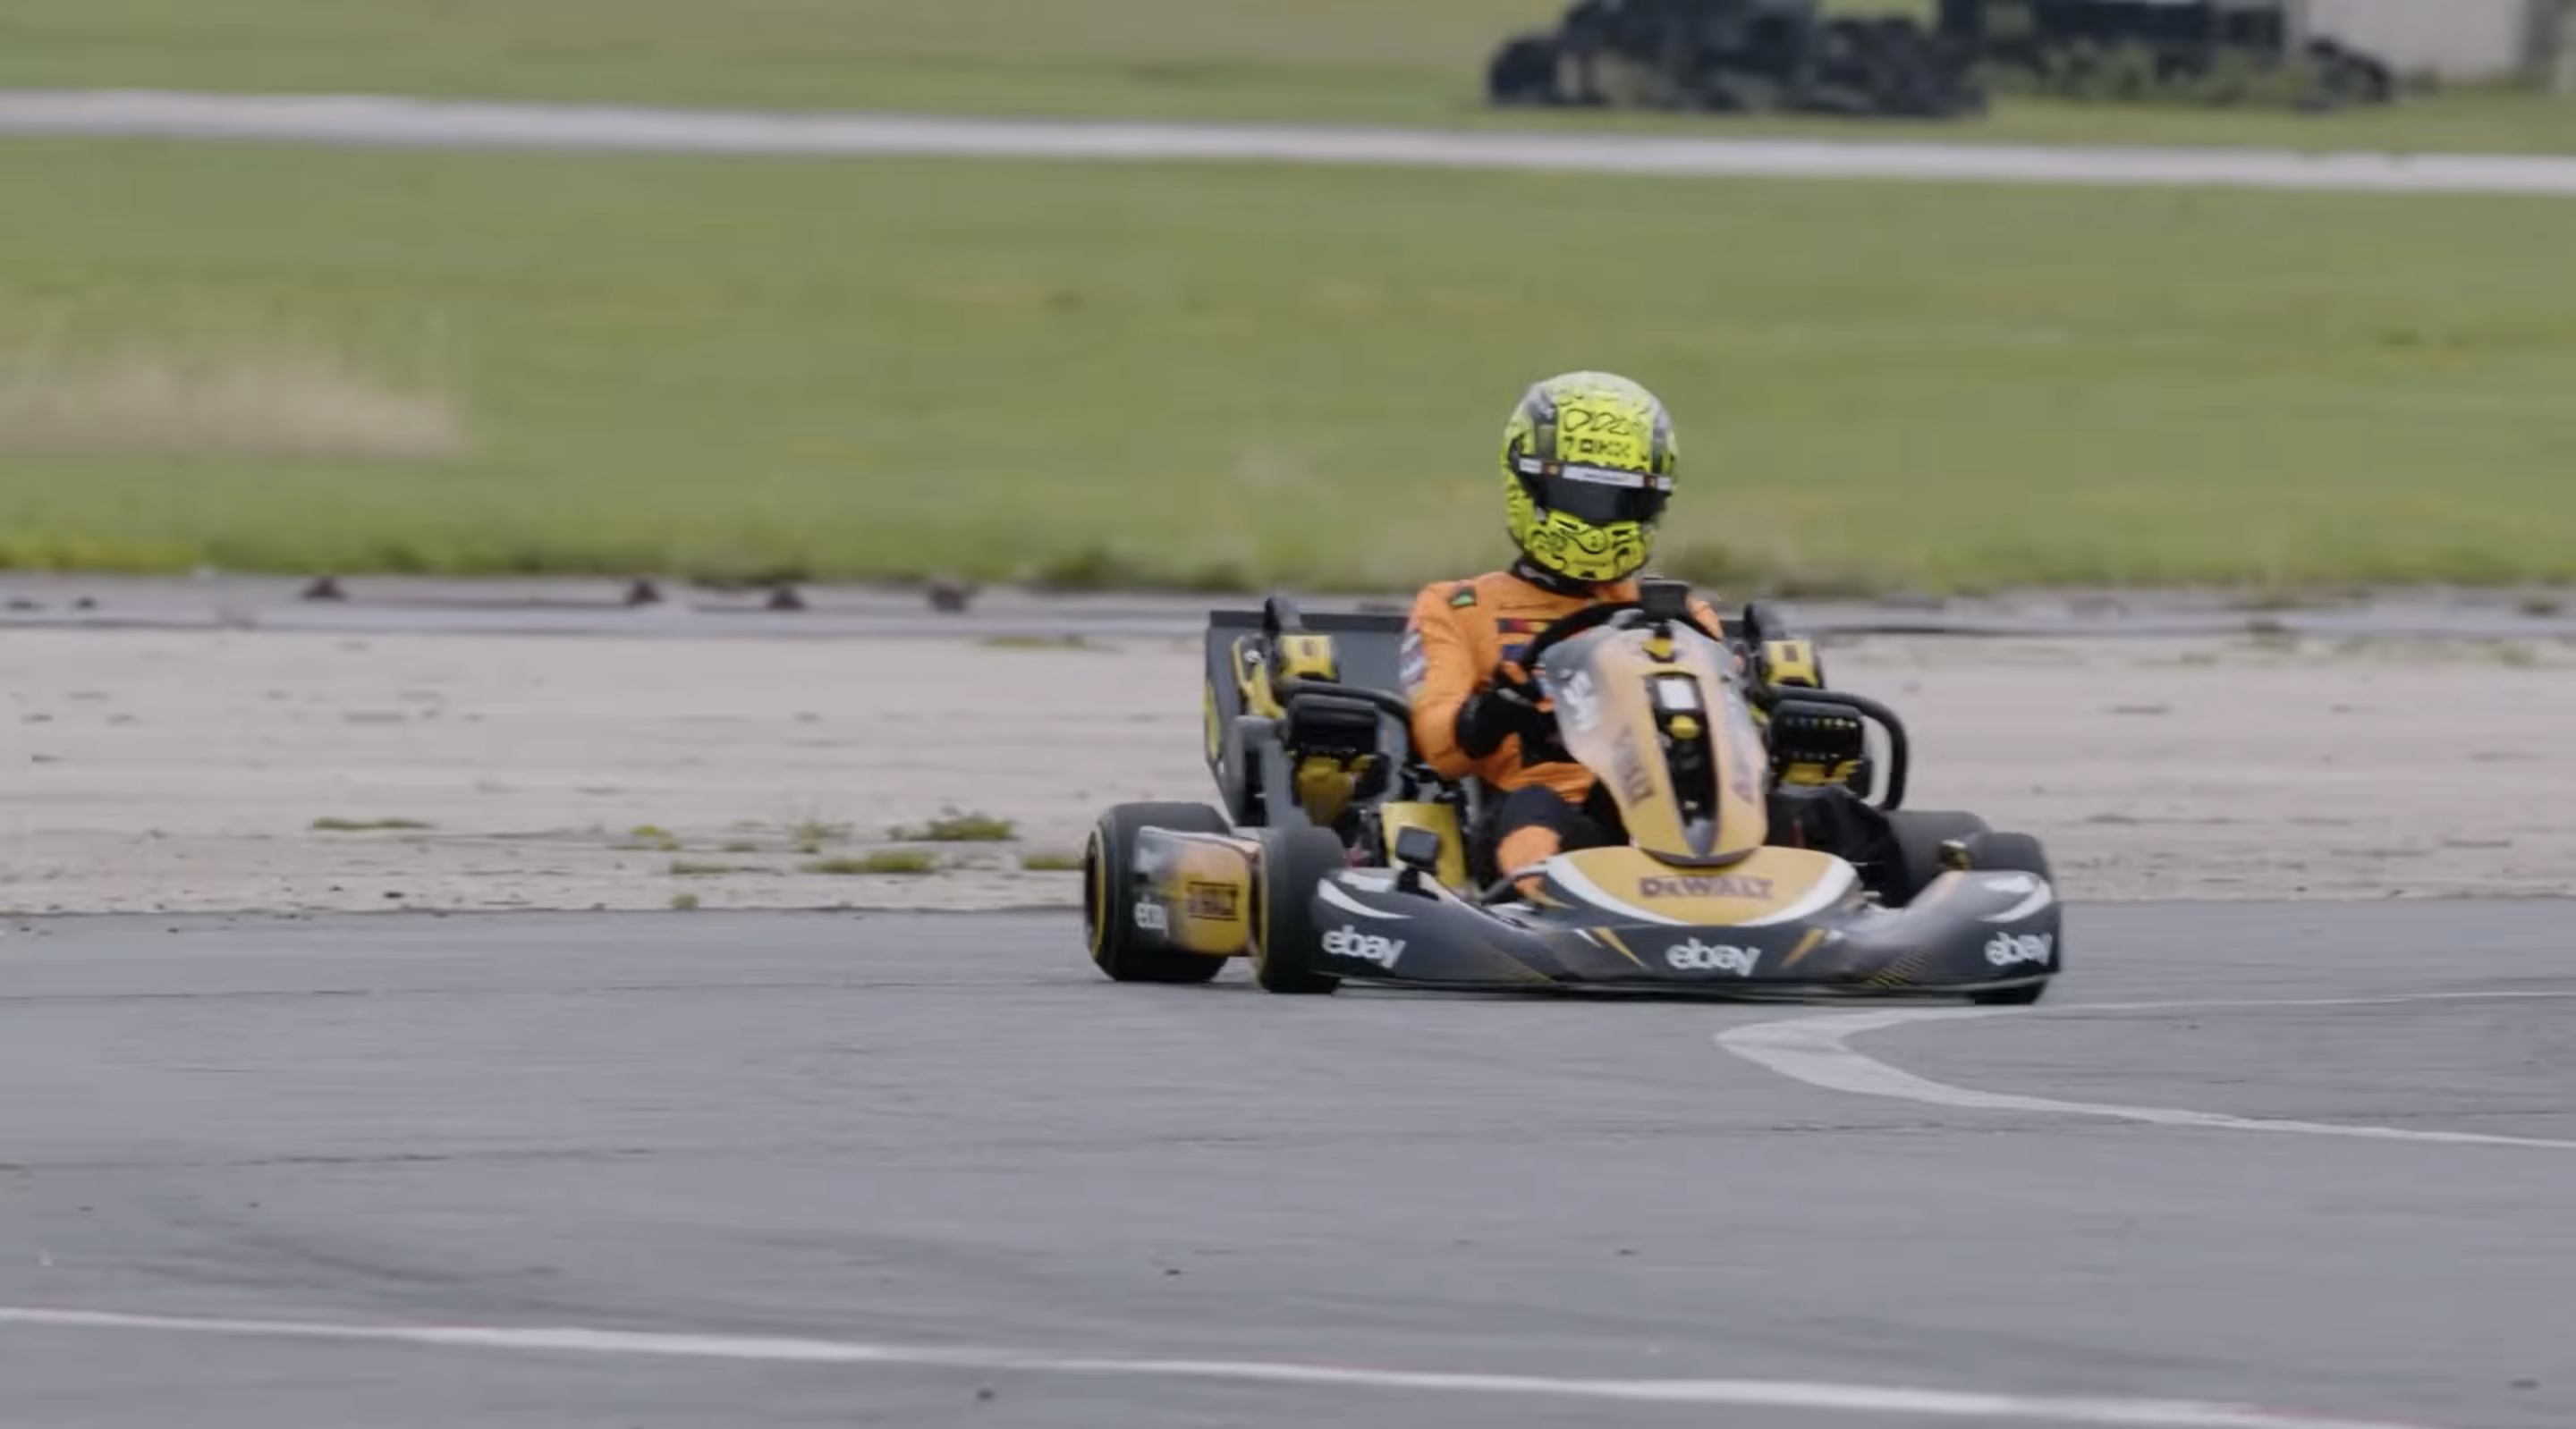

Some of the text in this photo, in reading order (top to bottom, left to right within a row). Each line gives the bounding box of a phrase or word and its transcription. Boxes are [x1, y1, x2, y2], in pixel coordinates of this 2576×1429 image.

[1322, 925, 1406, 968] ebay
[1665, 937, 1761, 977] ebay
[1985, 932, 2053, 966] ebay
